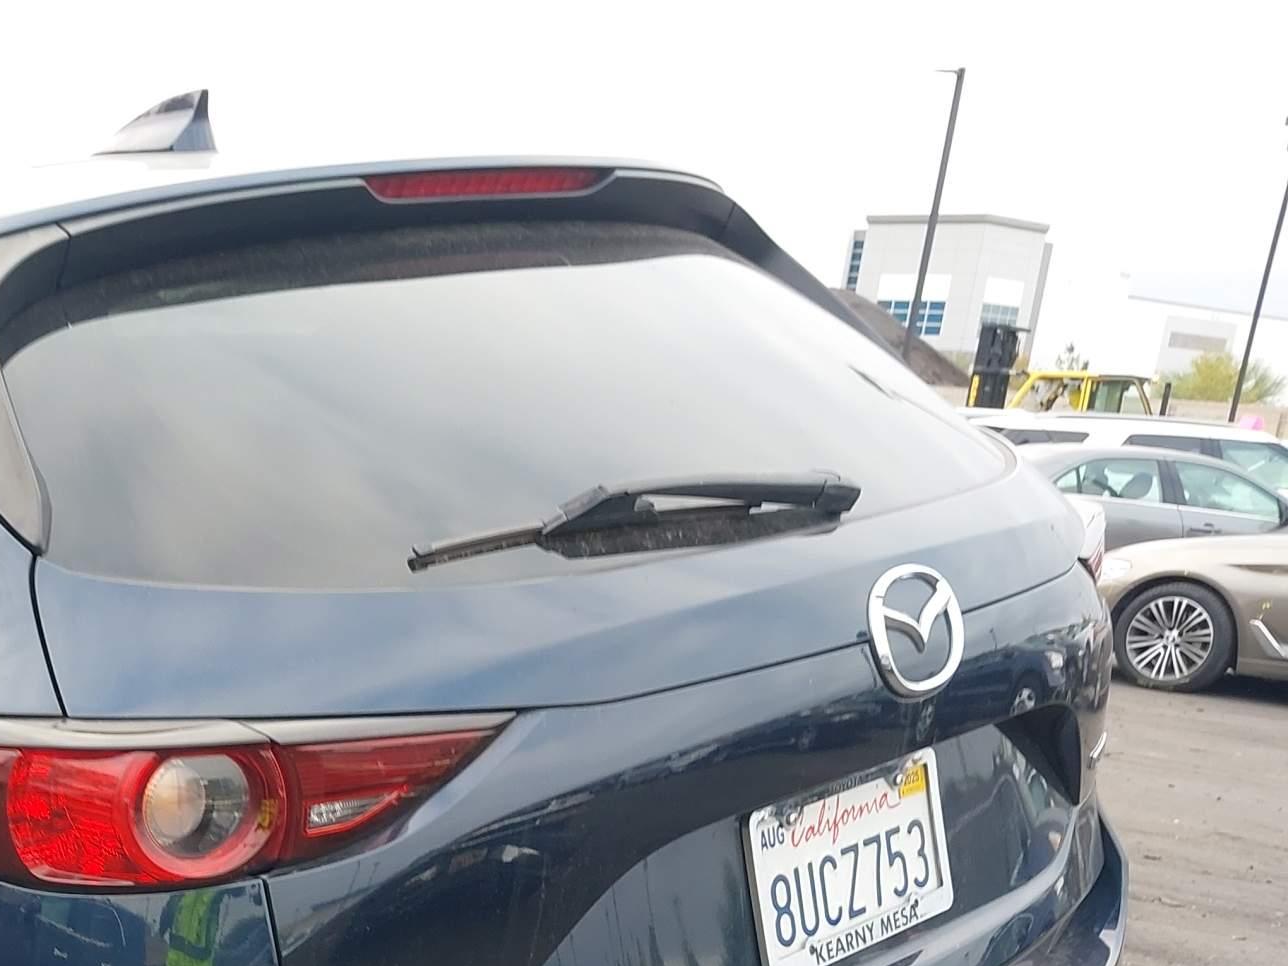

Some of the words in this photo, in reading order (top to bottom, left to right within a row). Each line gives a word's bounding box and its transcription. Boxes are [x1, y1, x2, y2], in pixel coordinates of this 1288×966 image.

[761, 826, 785, 851] AUG
[790, 791, 901, 847] California
[770, 818, 930, 948] 8UCZ753
[814, 921, 876, 966] KEARNY
[880, 904, 919, 936] MESA
